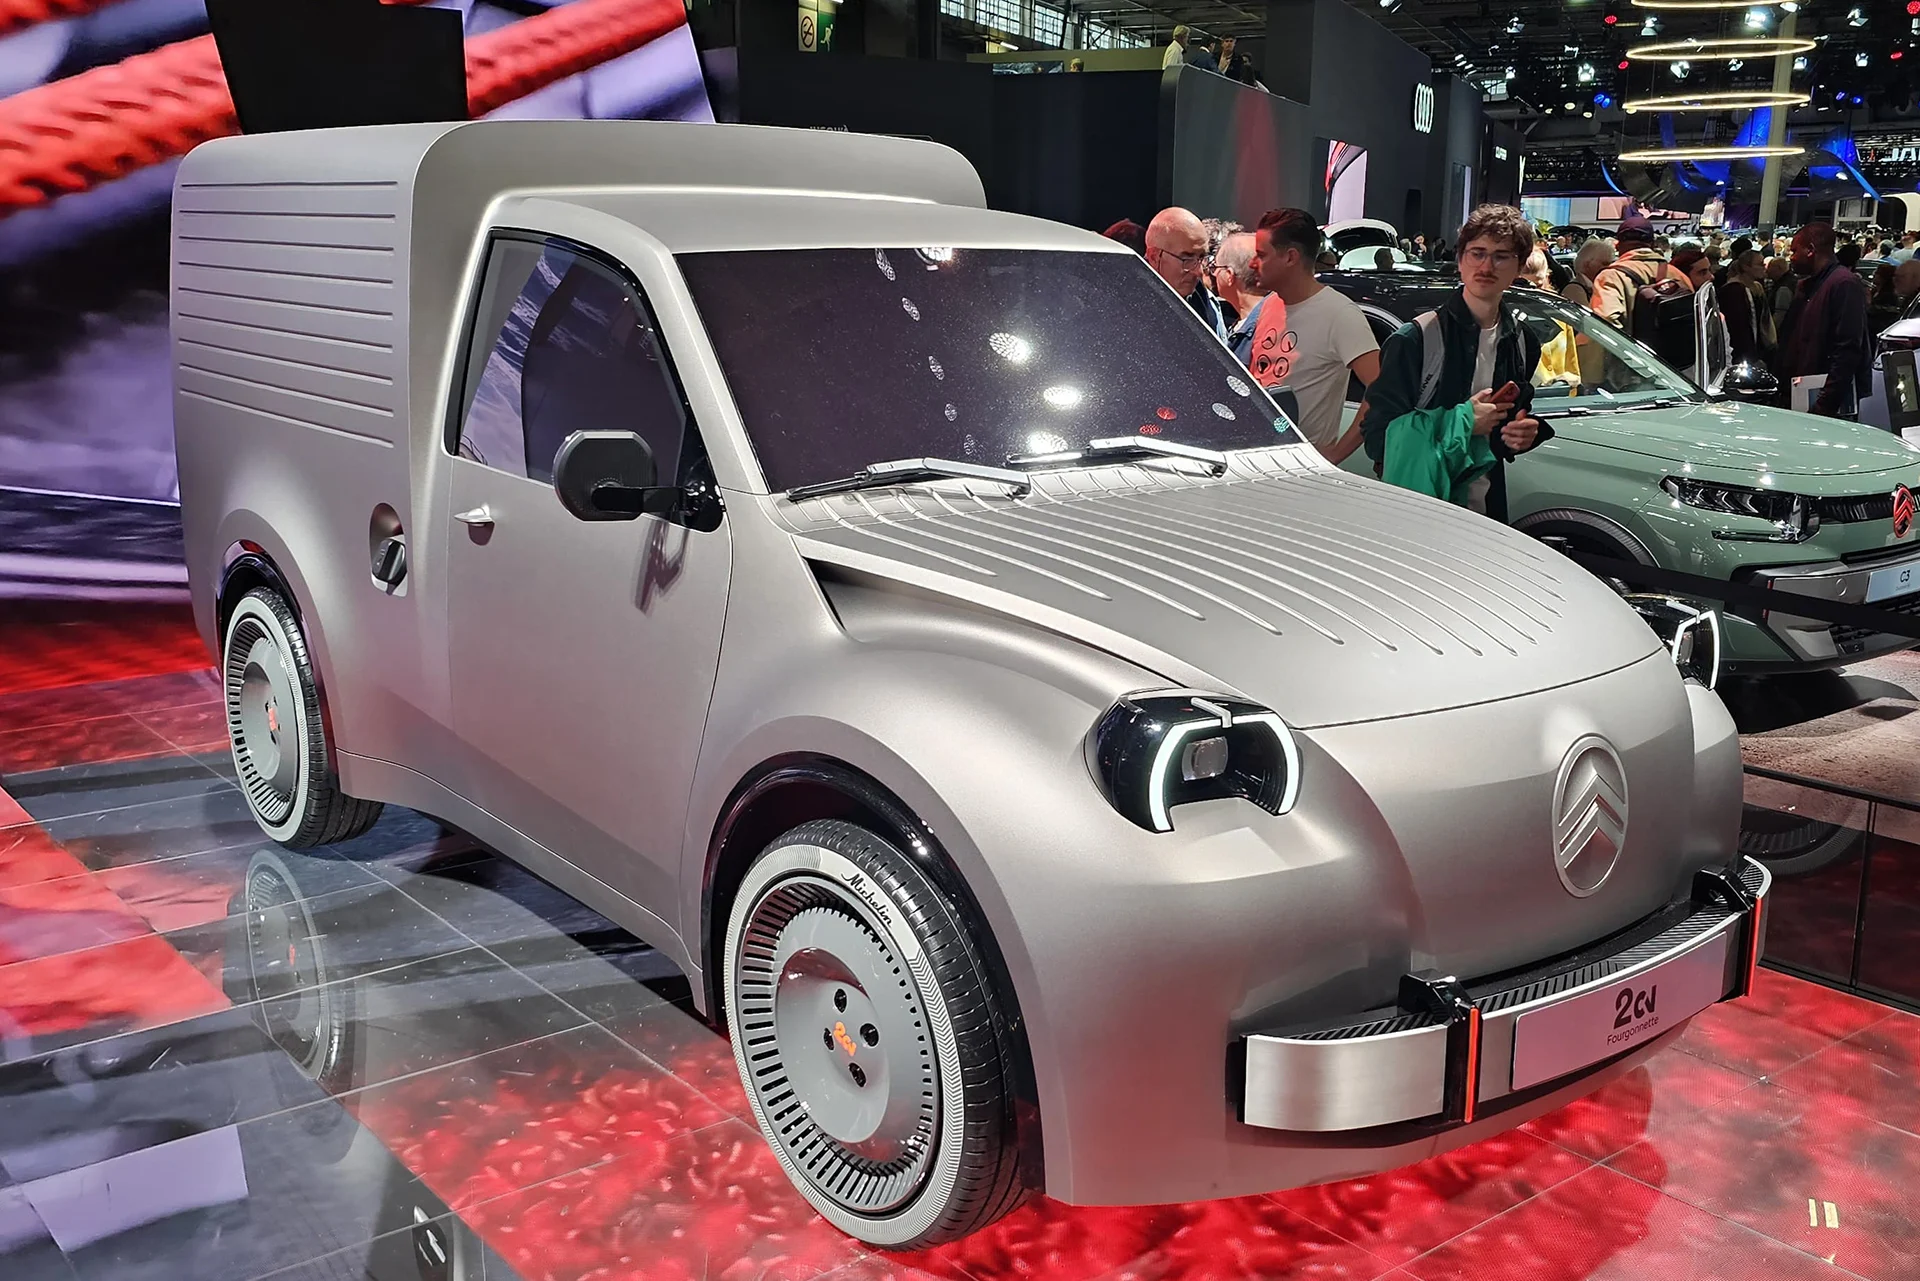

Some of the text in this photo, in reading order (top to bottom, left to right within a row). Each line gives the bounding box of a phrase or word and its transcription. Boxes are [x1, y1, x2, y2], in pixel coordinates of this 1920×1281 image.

[1899, 569, 1911, 583] C3
[841, 873, 893, 927] Michelin
[1606, 1016, 1659, 1046] Fourgonnette
